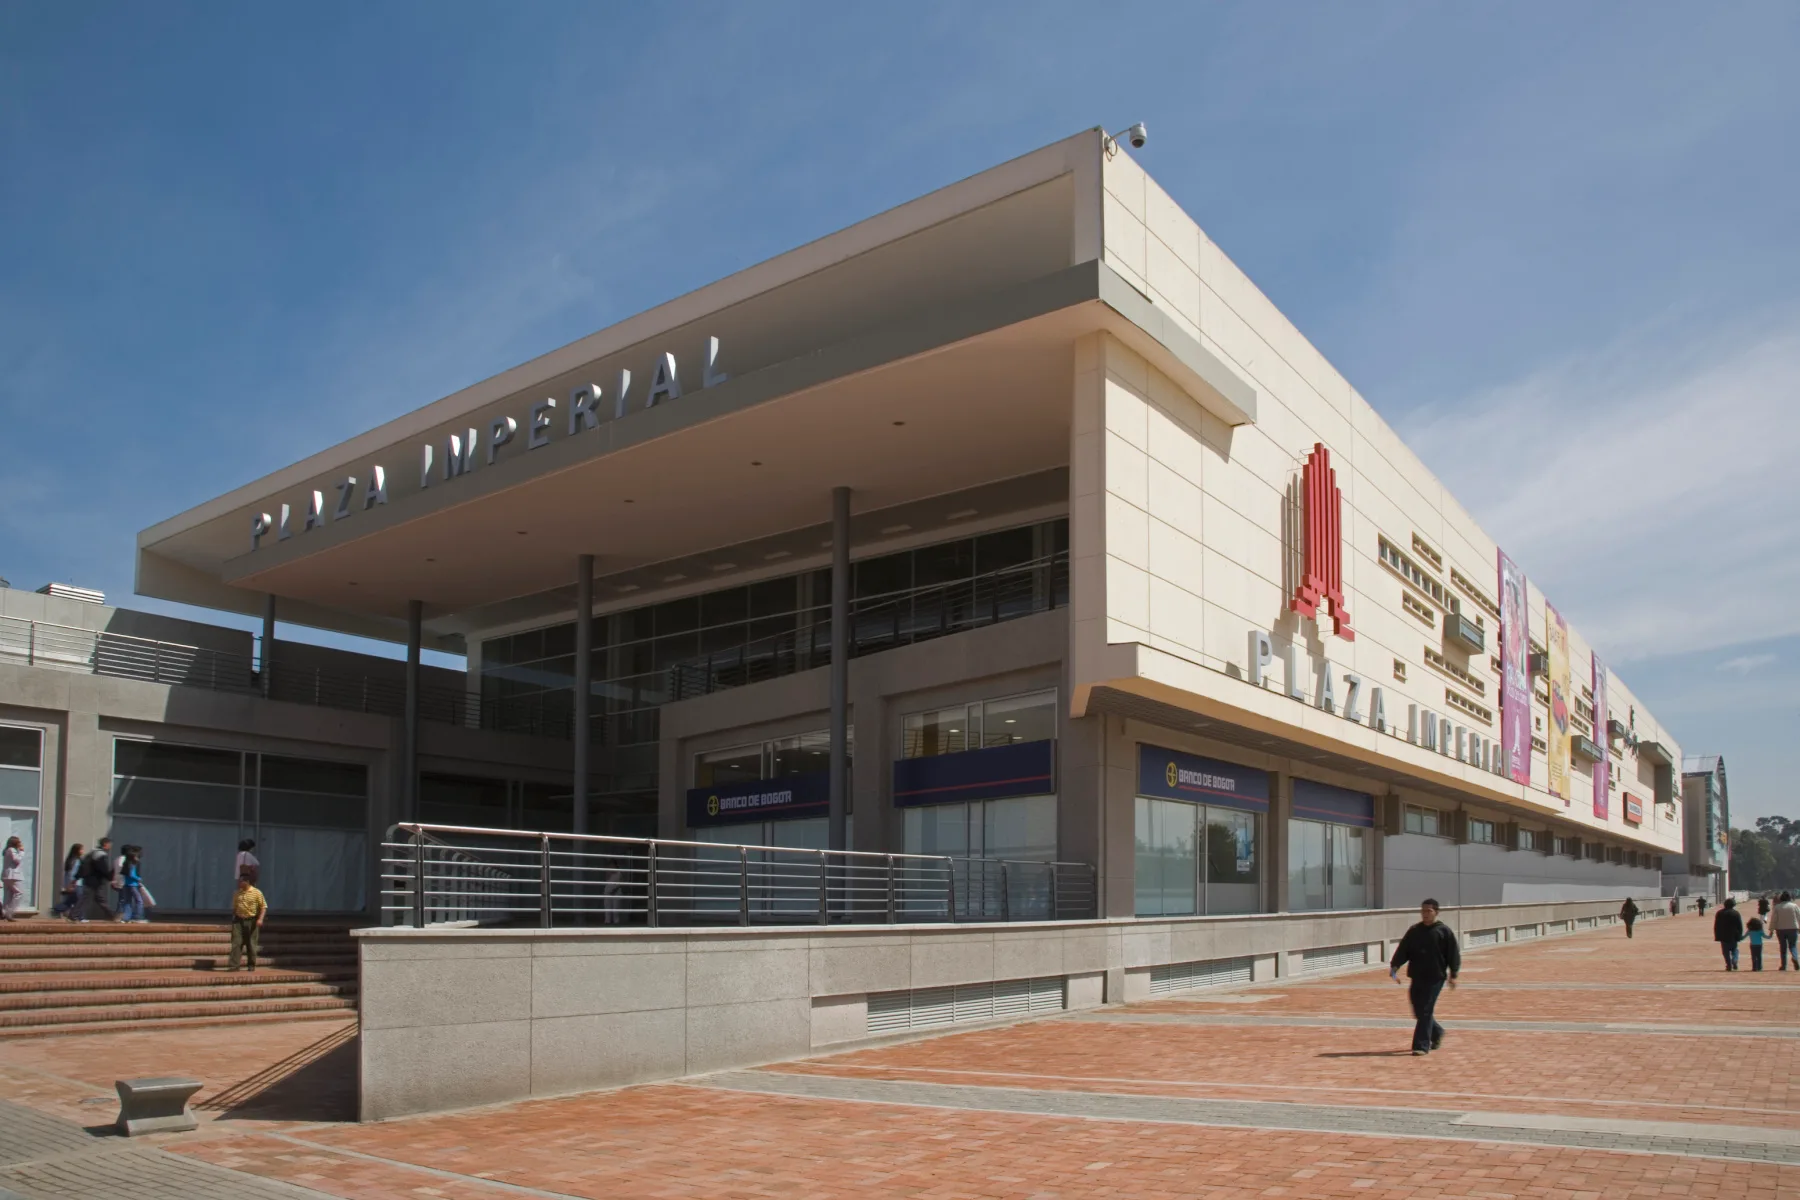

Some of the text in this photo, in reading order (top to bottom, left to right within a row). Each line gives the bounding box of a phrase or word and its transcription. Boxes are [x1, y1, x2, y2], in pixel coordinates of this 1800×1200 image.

[249, 336, 728, 550] PLAZA IMPERIAL
[1248, 630, 1515, 780] PLAZA IMPERIAL
[720, 796, 747, 810] BANCO
[748, 794, 759, 807] DE
[1178, 769, 1202, 785] BANCO
[1203, 773, 1212, 788] DE
